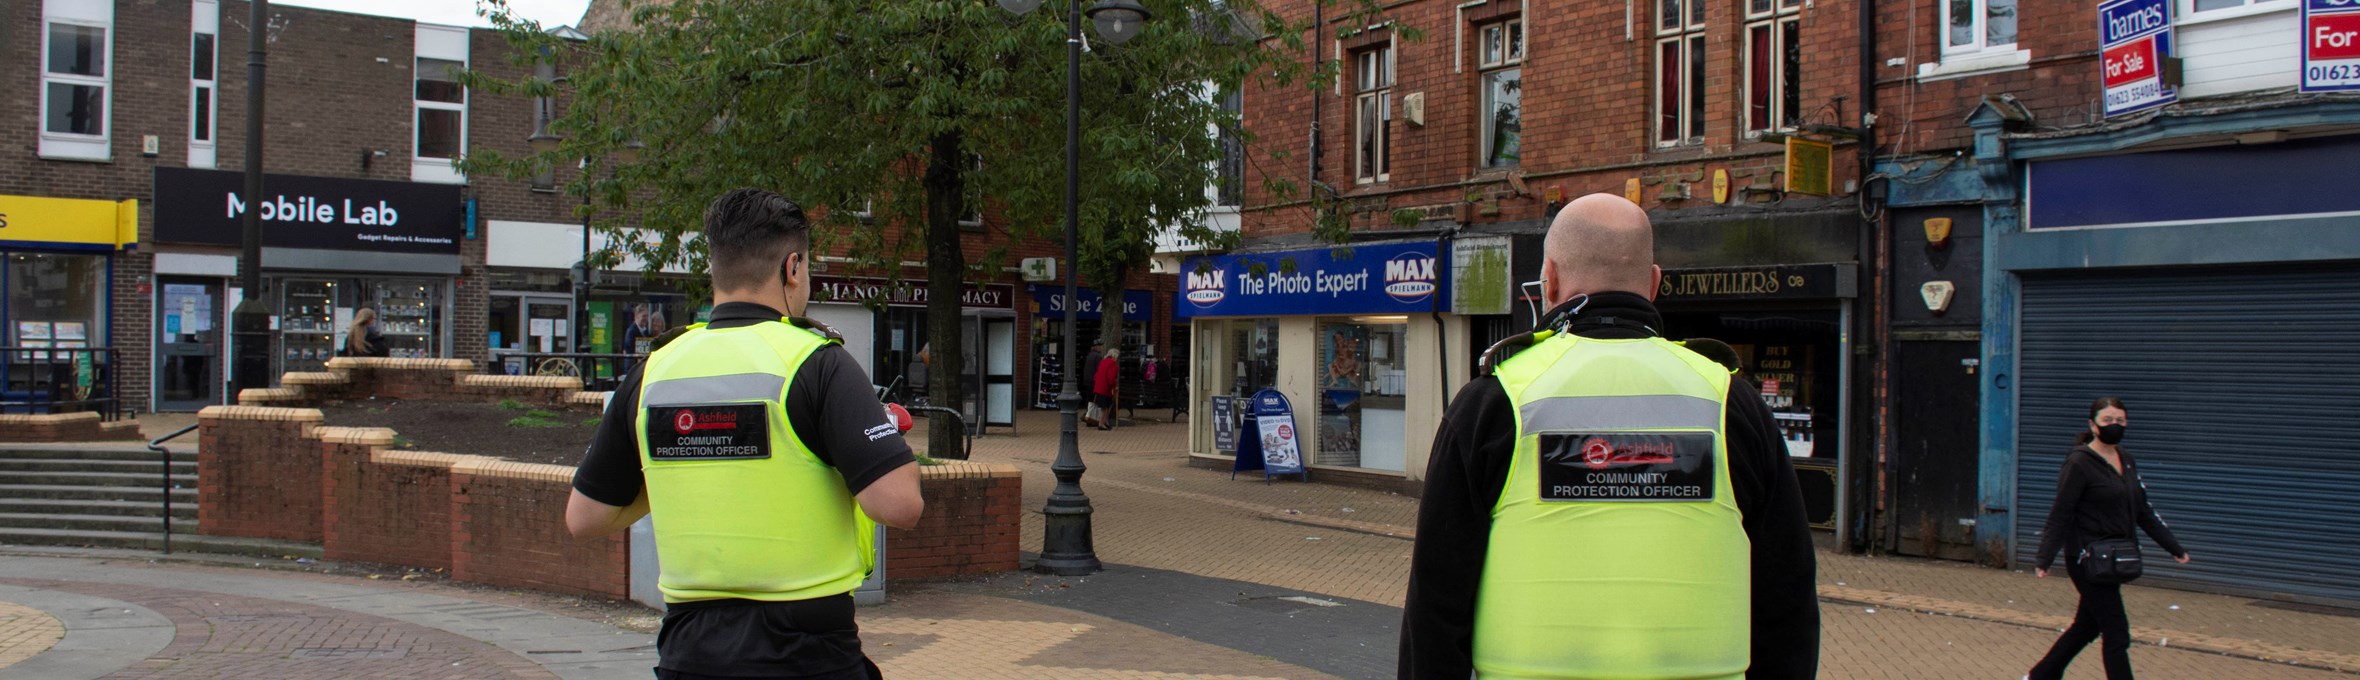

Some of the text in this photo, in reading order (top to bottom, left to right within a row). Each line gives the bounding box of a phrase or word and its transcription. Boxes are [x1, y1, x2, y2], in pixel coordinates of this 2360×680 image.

[2107, 4, 2163, 40] barnes
[2315, 26, 2358, 49] For
[2105, 51, 2144, 79] For Sale
[2108, 90, 2129, 107] 01623
[344, 198, 398, 226] Lab
[357, 233, 382, 242] Gadget
[383, 234, 407, 243] Repairs
[414, 236, 453, 244] Accessories
[1386, 258, 1436, 281] MAX
[1187, 269, 1225, 290] MAX
[1238, 268, 1369, 299] The Photo Expert
[1676, 270, 1780, 295] JEWELLERS
[1390, 284, 1431, 292] SPIELMANN
[1190, 292, 1222, 300] SPIELMANN
[1760, 360, 1792, 369] GOLD
[698, 411, 737, 422] Ashfield
[677, 436, 733, 446] COMMUNITY
[657, 445, 758, 456] PROTECTION OFFICER
[1617, 442, 1674, 455] Ashfield
[1586, 472, 1668, 484] COMMUNITY
[1553, 485, 1701, 497] PROTECTION OFFICER
